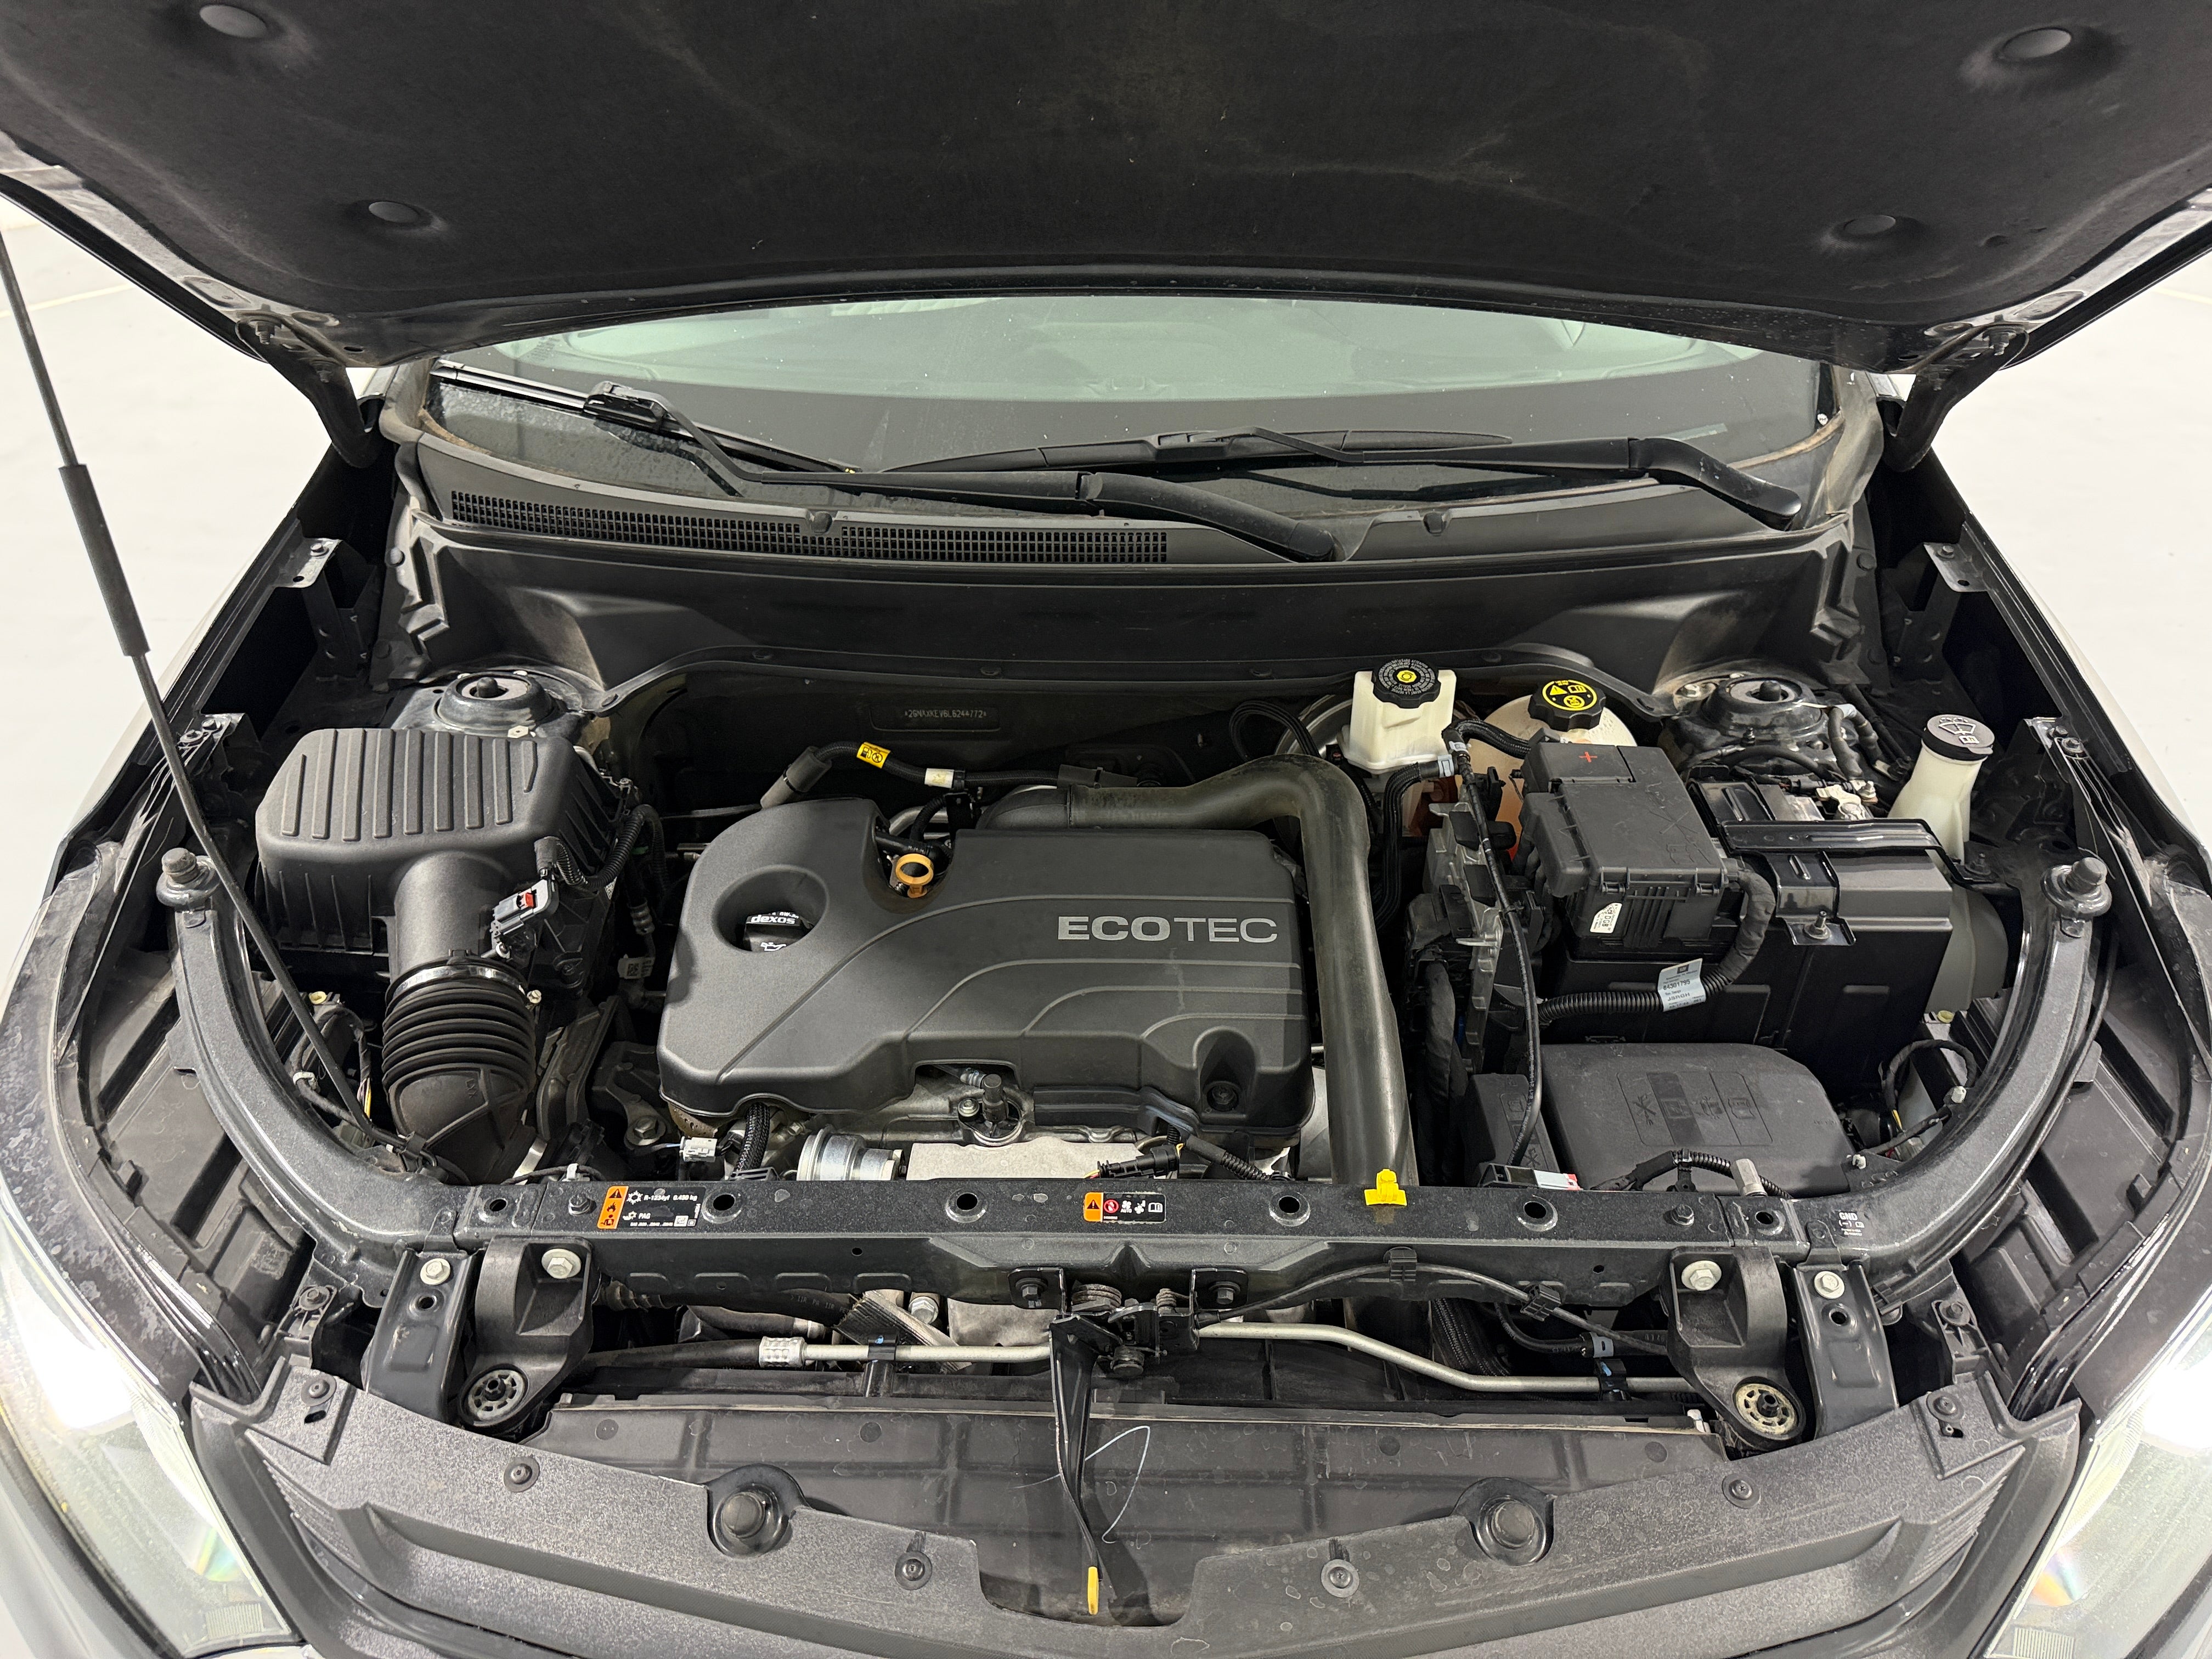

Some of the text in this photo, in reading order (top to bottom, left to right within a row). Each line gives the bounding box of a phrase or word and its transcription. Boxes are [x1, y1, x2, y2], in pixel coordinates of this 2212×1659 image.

[751, 914, 796, 924] dexos
[1058, 916, 1278, 943] ECOTEC
[1838, 1212, 1858, 1221] GND
